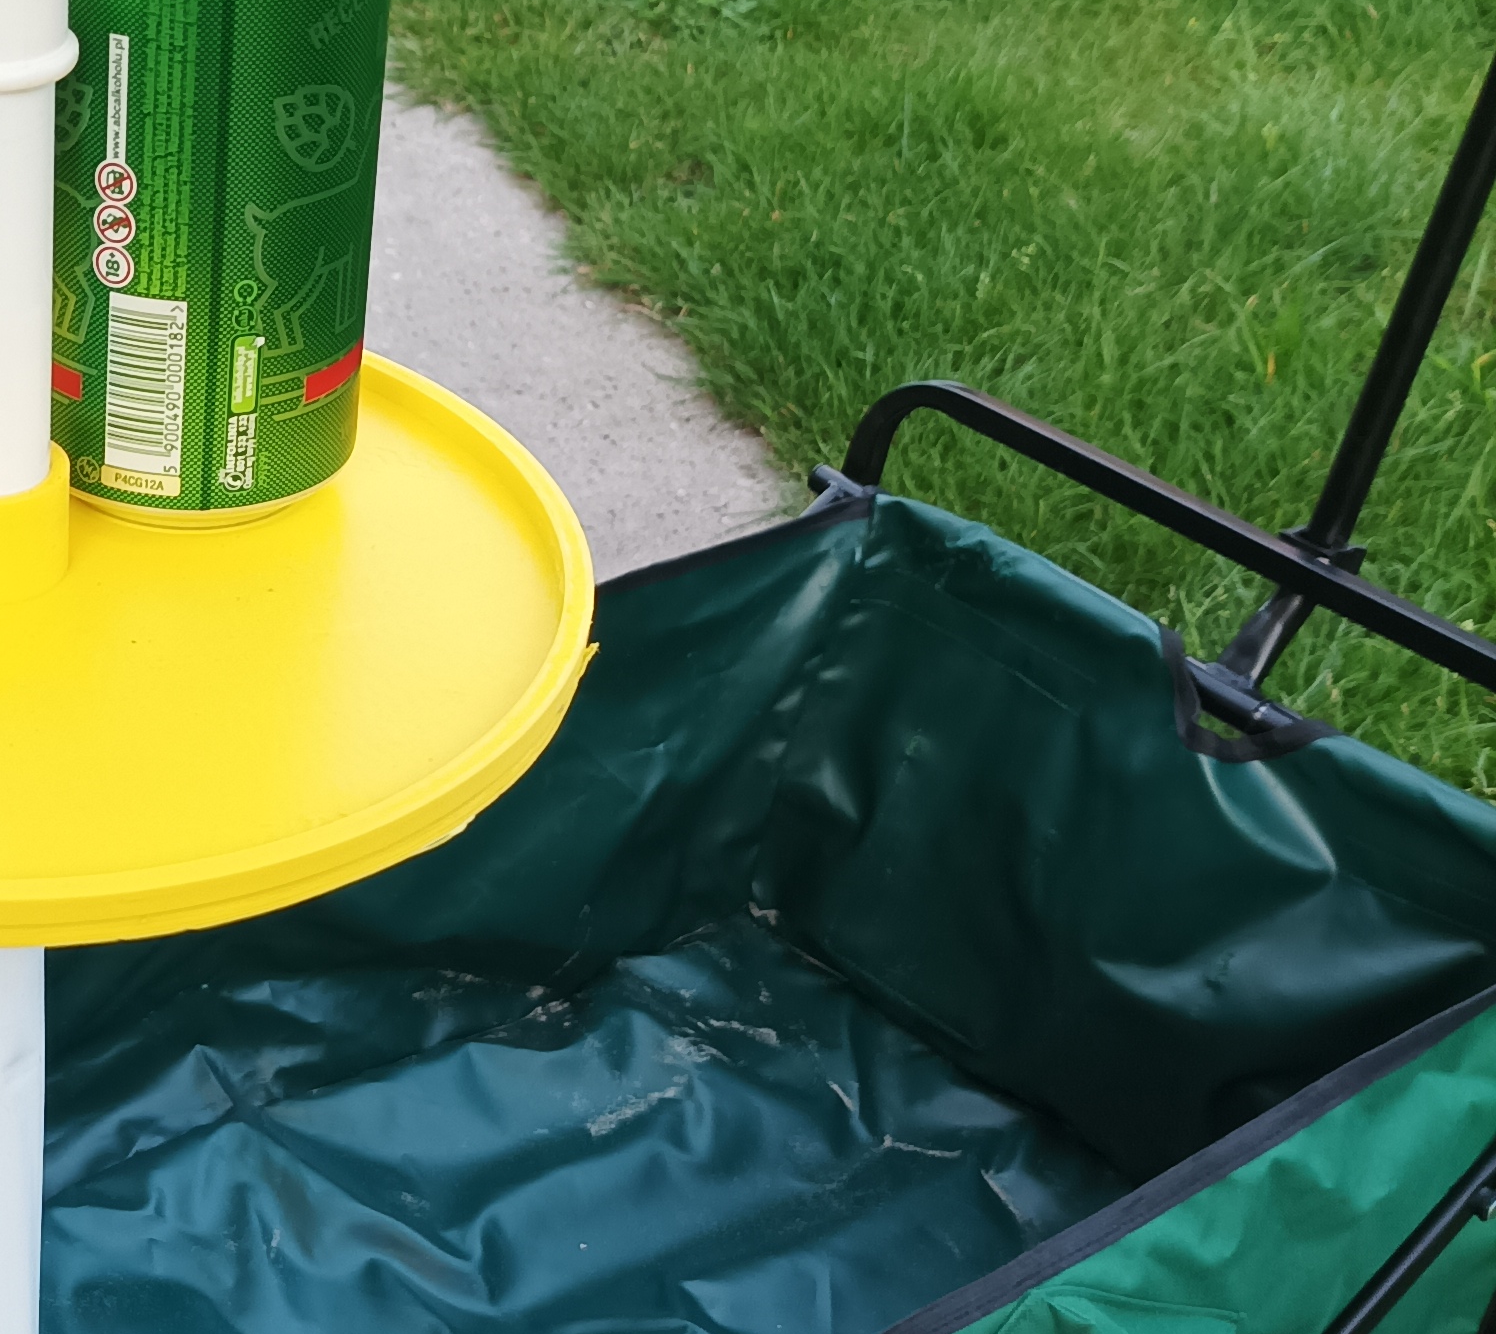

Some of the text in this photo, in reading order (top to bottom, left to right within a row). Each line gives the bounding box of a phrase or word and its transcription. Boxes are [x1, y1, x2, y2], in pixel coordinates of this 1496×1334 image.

[111, 38, 126, 159] www.abcalkoholu.pl
[106, 252, 120, 277] 18+
[163, 322, 185, 473] 5 900490 000182
[114, 471, 164, 491] P4CG12A
